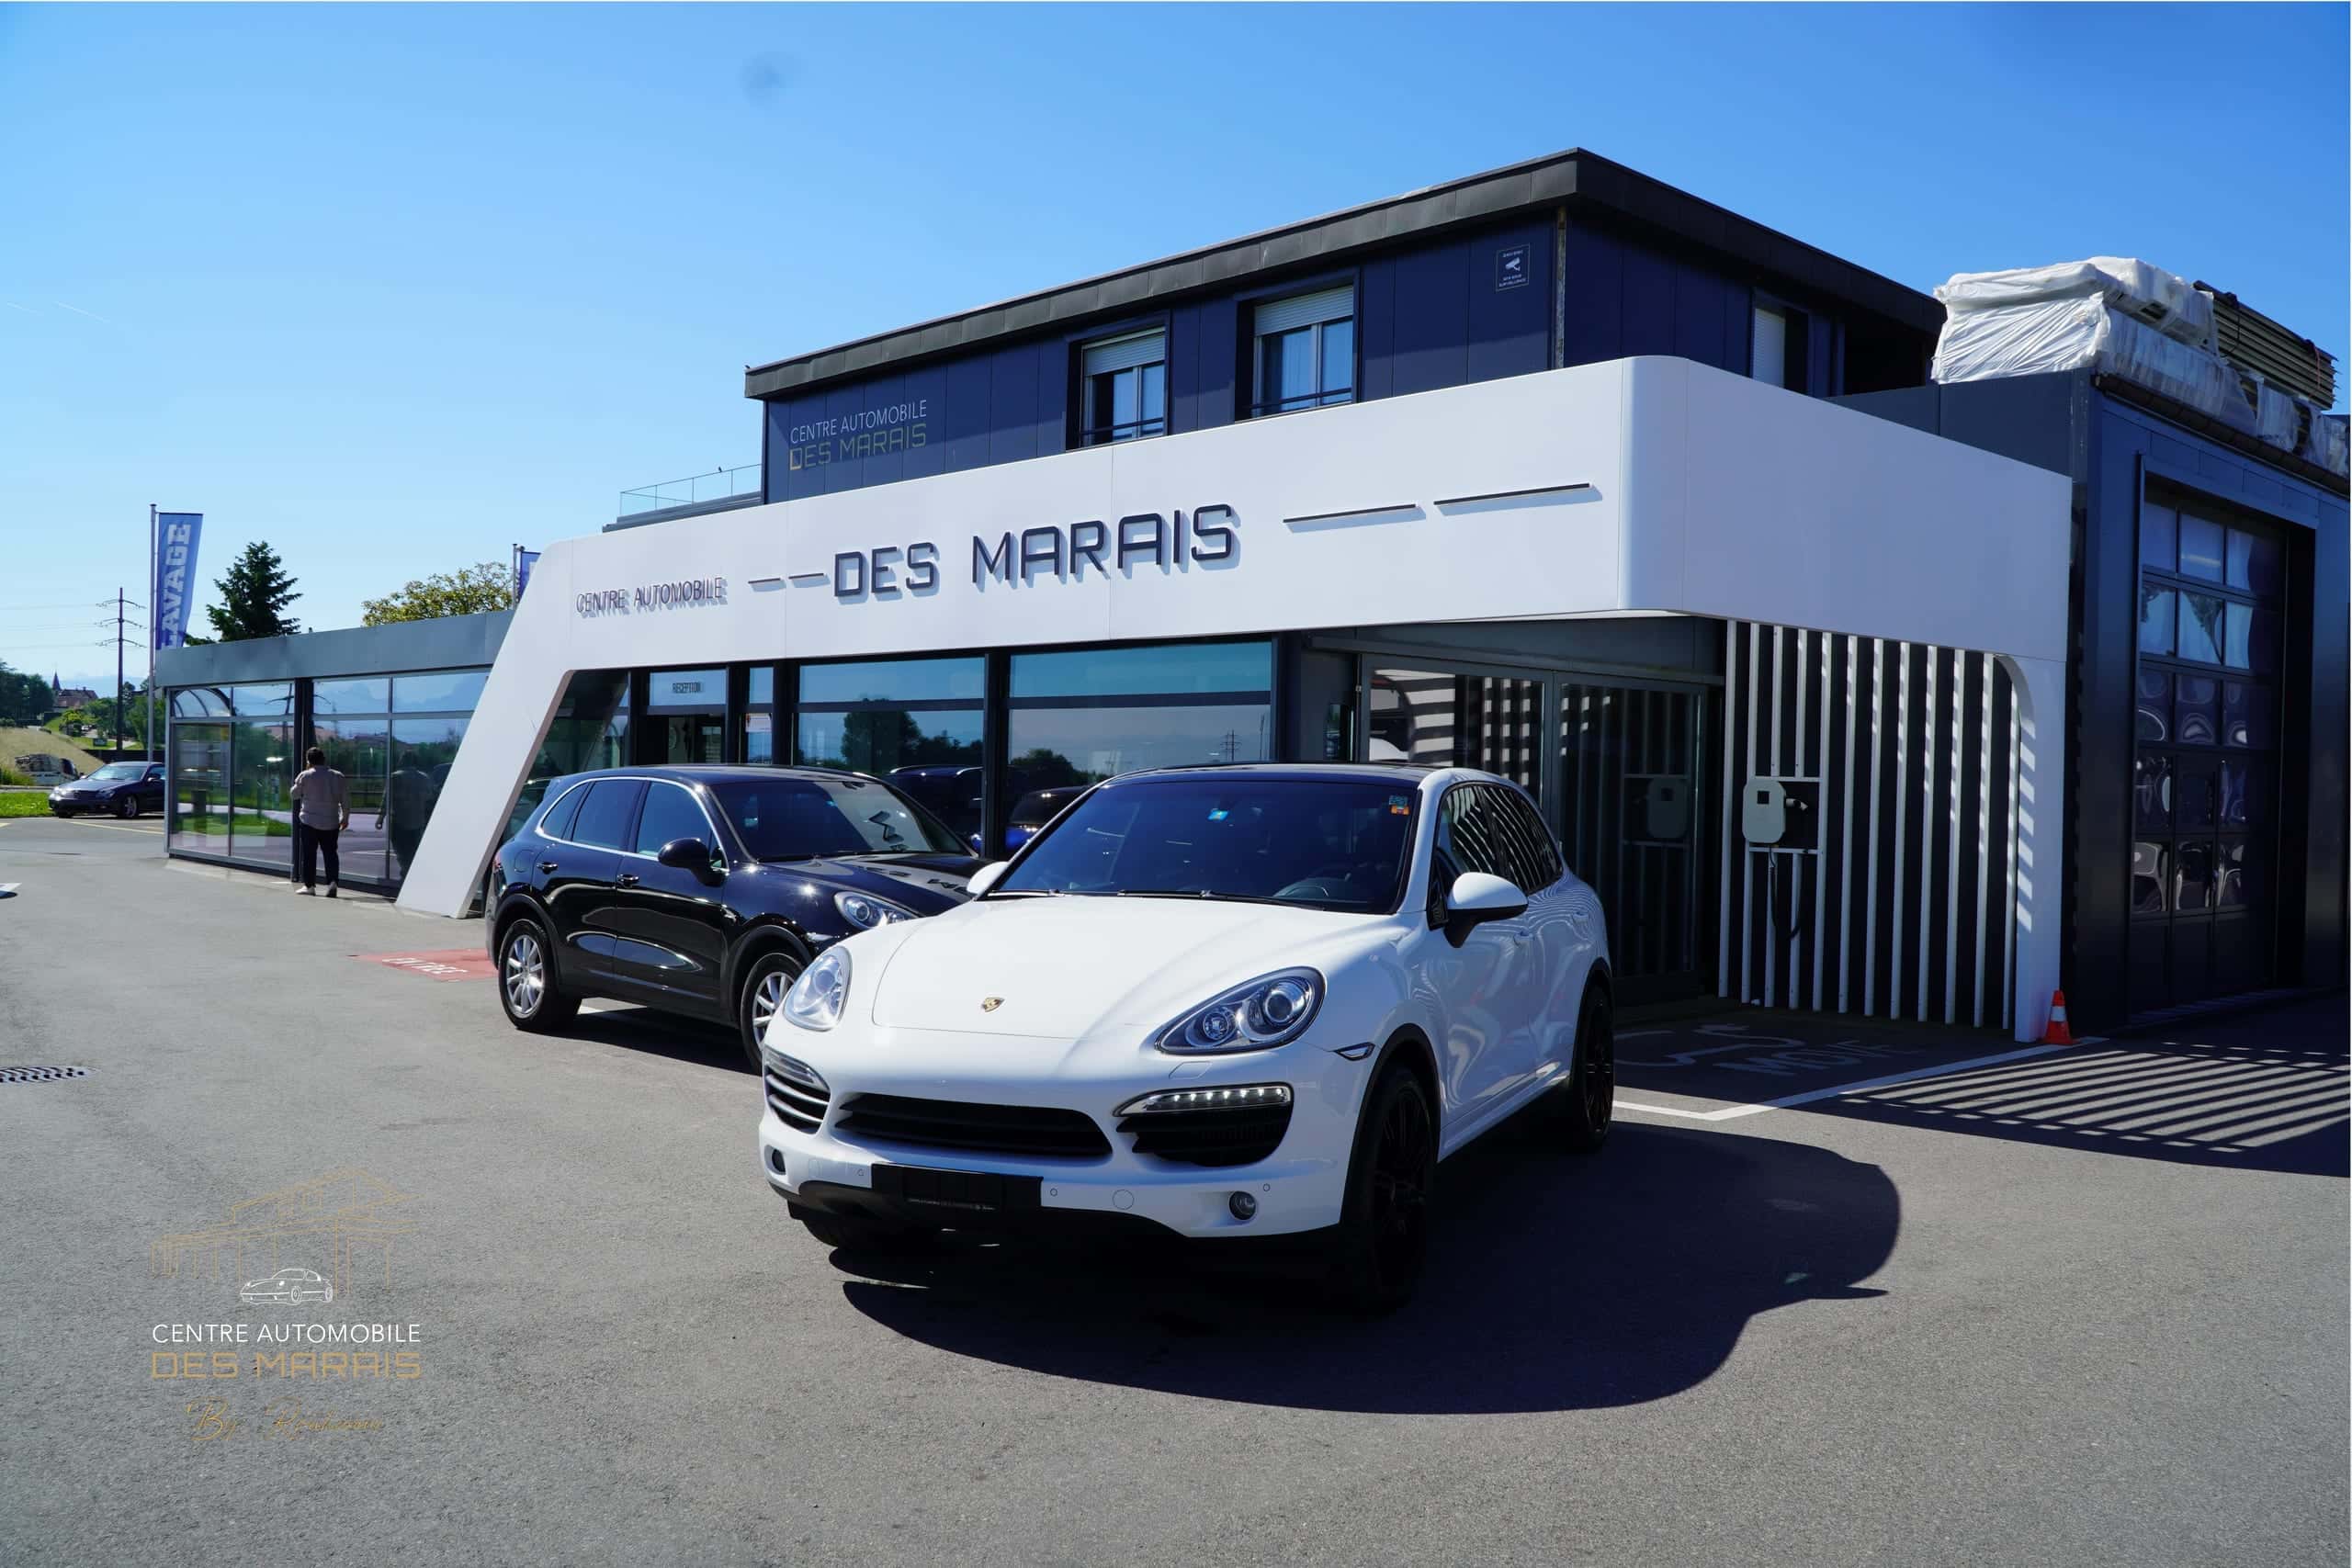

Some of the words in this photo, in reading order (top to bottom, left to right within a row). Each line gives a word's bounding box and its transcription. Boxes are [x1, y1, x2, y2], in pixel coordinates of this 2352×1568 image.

[790, 418, 837, 445] CENTRE
[840, 399, 927, 434] AUTOMOBILE
[789, 441, 831, 471] DES
[839, 423, 927, 459] MARAIS
[833, 541, 935, 598] DES
[971, 502, 1232, 584] MARAIS
[160, 524, 191, 649] LAVAGE
[576, 588, 626, 614] CENTRE
[633, 577, 723, 607] AUTOMOBILE
